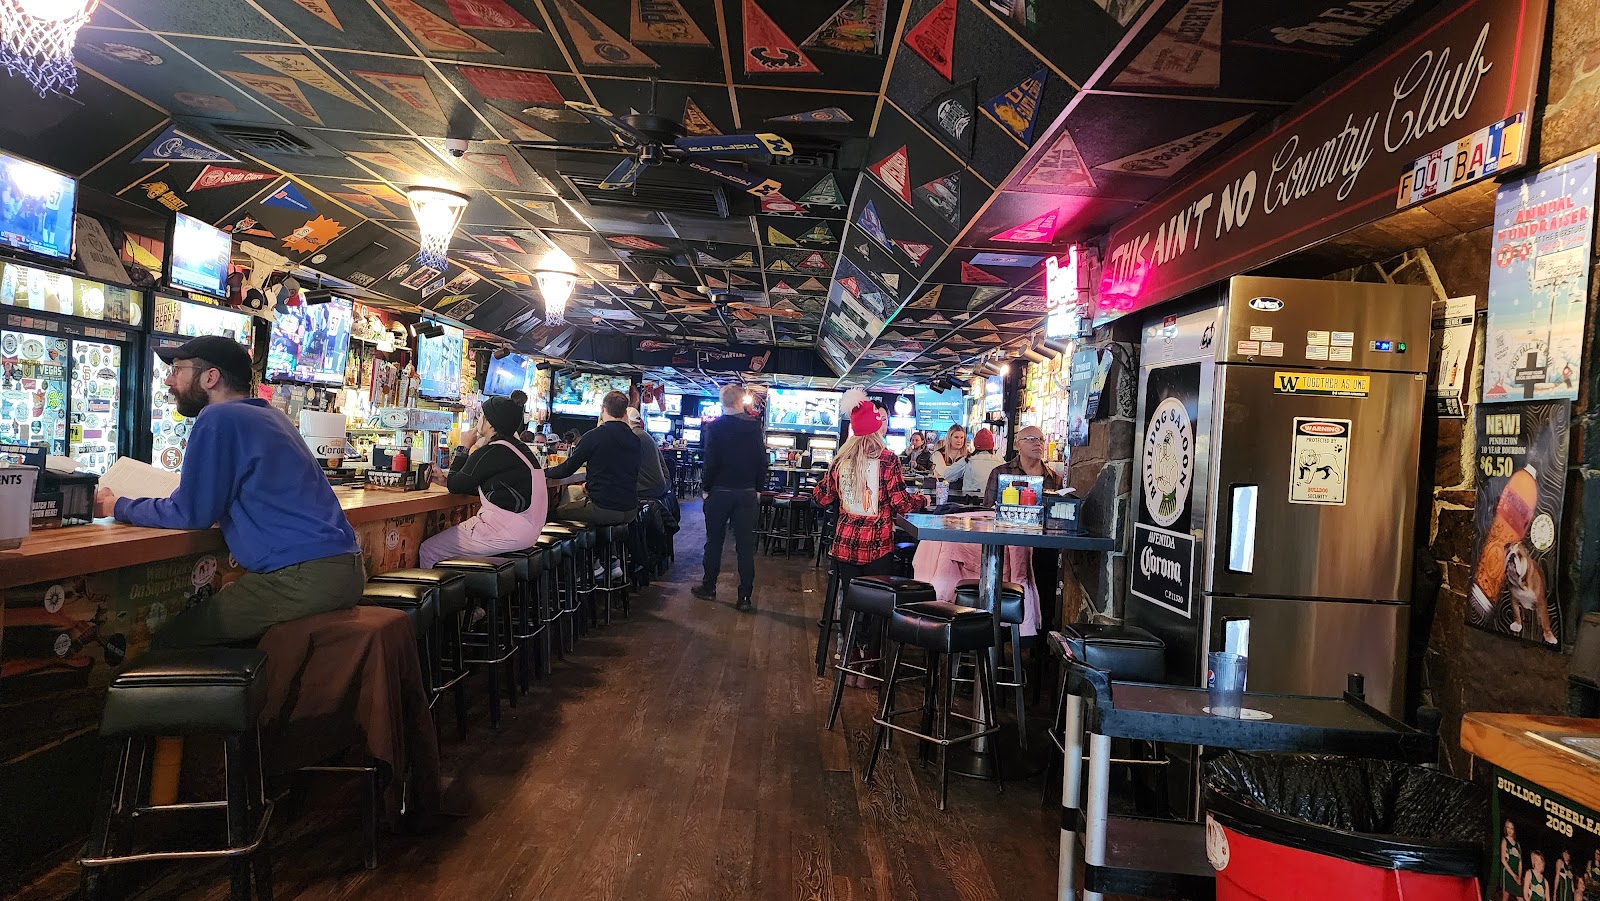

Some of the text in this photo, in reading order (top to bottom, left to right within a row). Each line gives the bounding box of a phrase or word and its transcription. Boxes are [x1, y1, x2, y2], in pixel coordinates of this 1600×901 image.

[1111, 22, 1493, 289] THIS AIN'T NO Country Club
[1400, 132, 1513, 200] FOOTBALL
[220, 171, 265, 184] Santa Clara
[1515, 195, 1576, 225] ANNUAL
[1497, 205, 1589, 242] FUNDRAISER
[40, 364, 63, 377] VEGAS
[1279, 375, 1366, 392] W TOGETHER AS ONE
[1304, 425, 1342, 433] WARNING
[1485, 413, 1521, 435] NEW!
[1481, 446, 1526, 455] 10 YEAR BOURBON
[1489, 437, 1518, 445] PENDLETON
[1146, 408, 1190, 500] BULLDOG SALOON
[1480, 455, 1514, 478] $6.50
[1147, 531, 1176, 550] AVENIDA
[1140, 545, 1182, 584] Corona
[1497, 776, 1542, 807] BULLDOG
[1545, 814, 1574, 838] 2009
